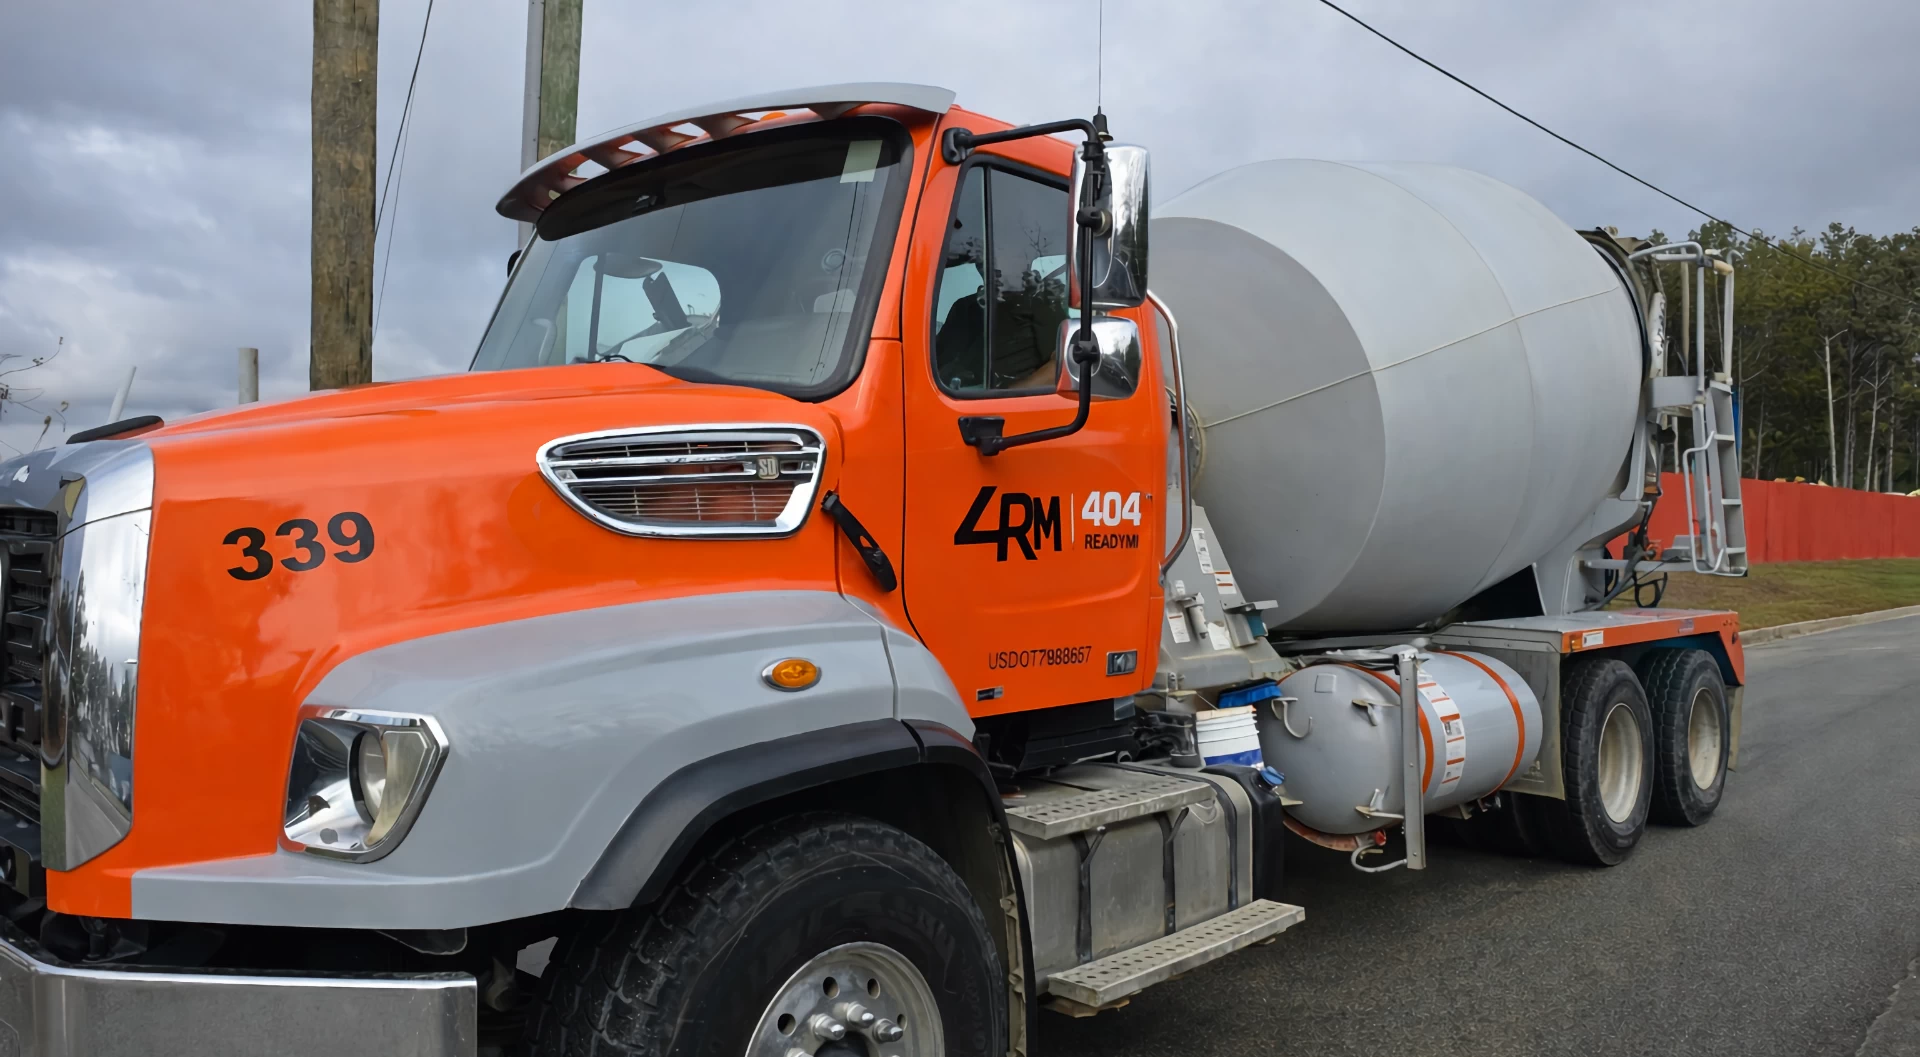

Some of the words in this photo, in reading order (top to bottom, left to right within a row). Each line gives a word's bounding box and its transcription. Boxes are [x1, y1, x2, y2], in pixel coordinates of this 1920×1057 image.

[759, 458, 777, 476] SD
[1081, 490, 1142, 527] 404
[222, 511, 375, 581] 339
